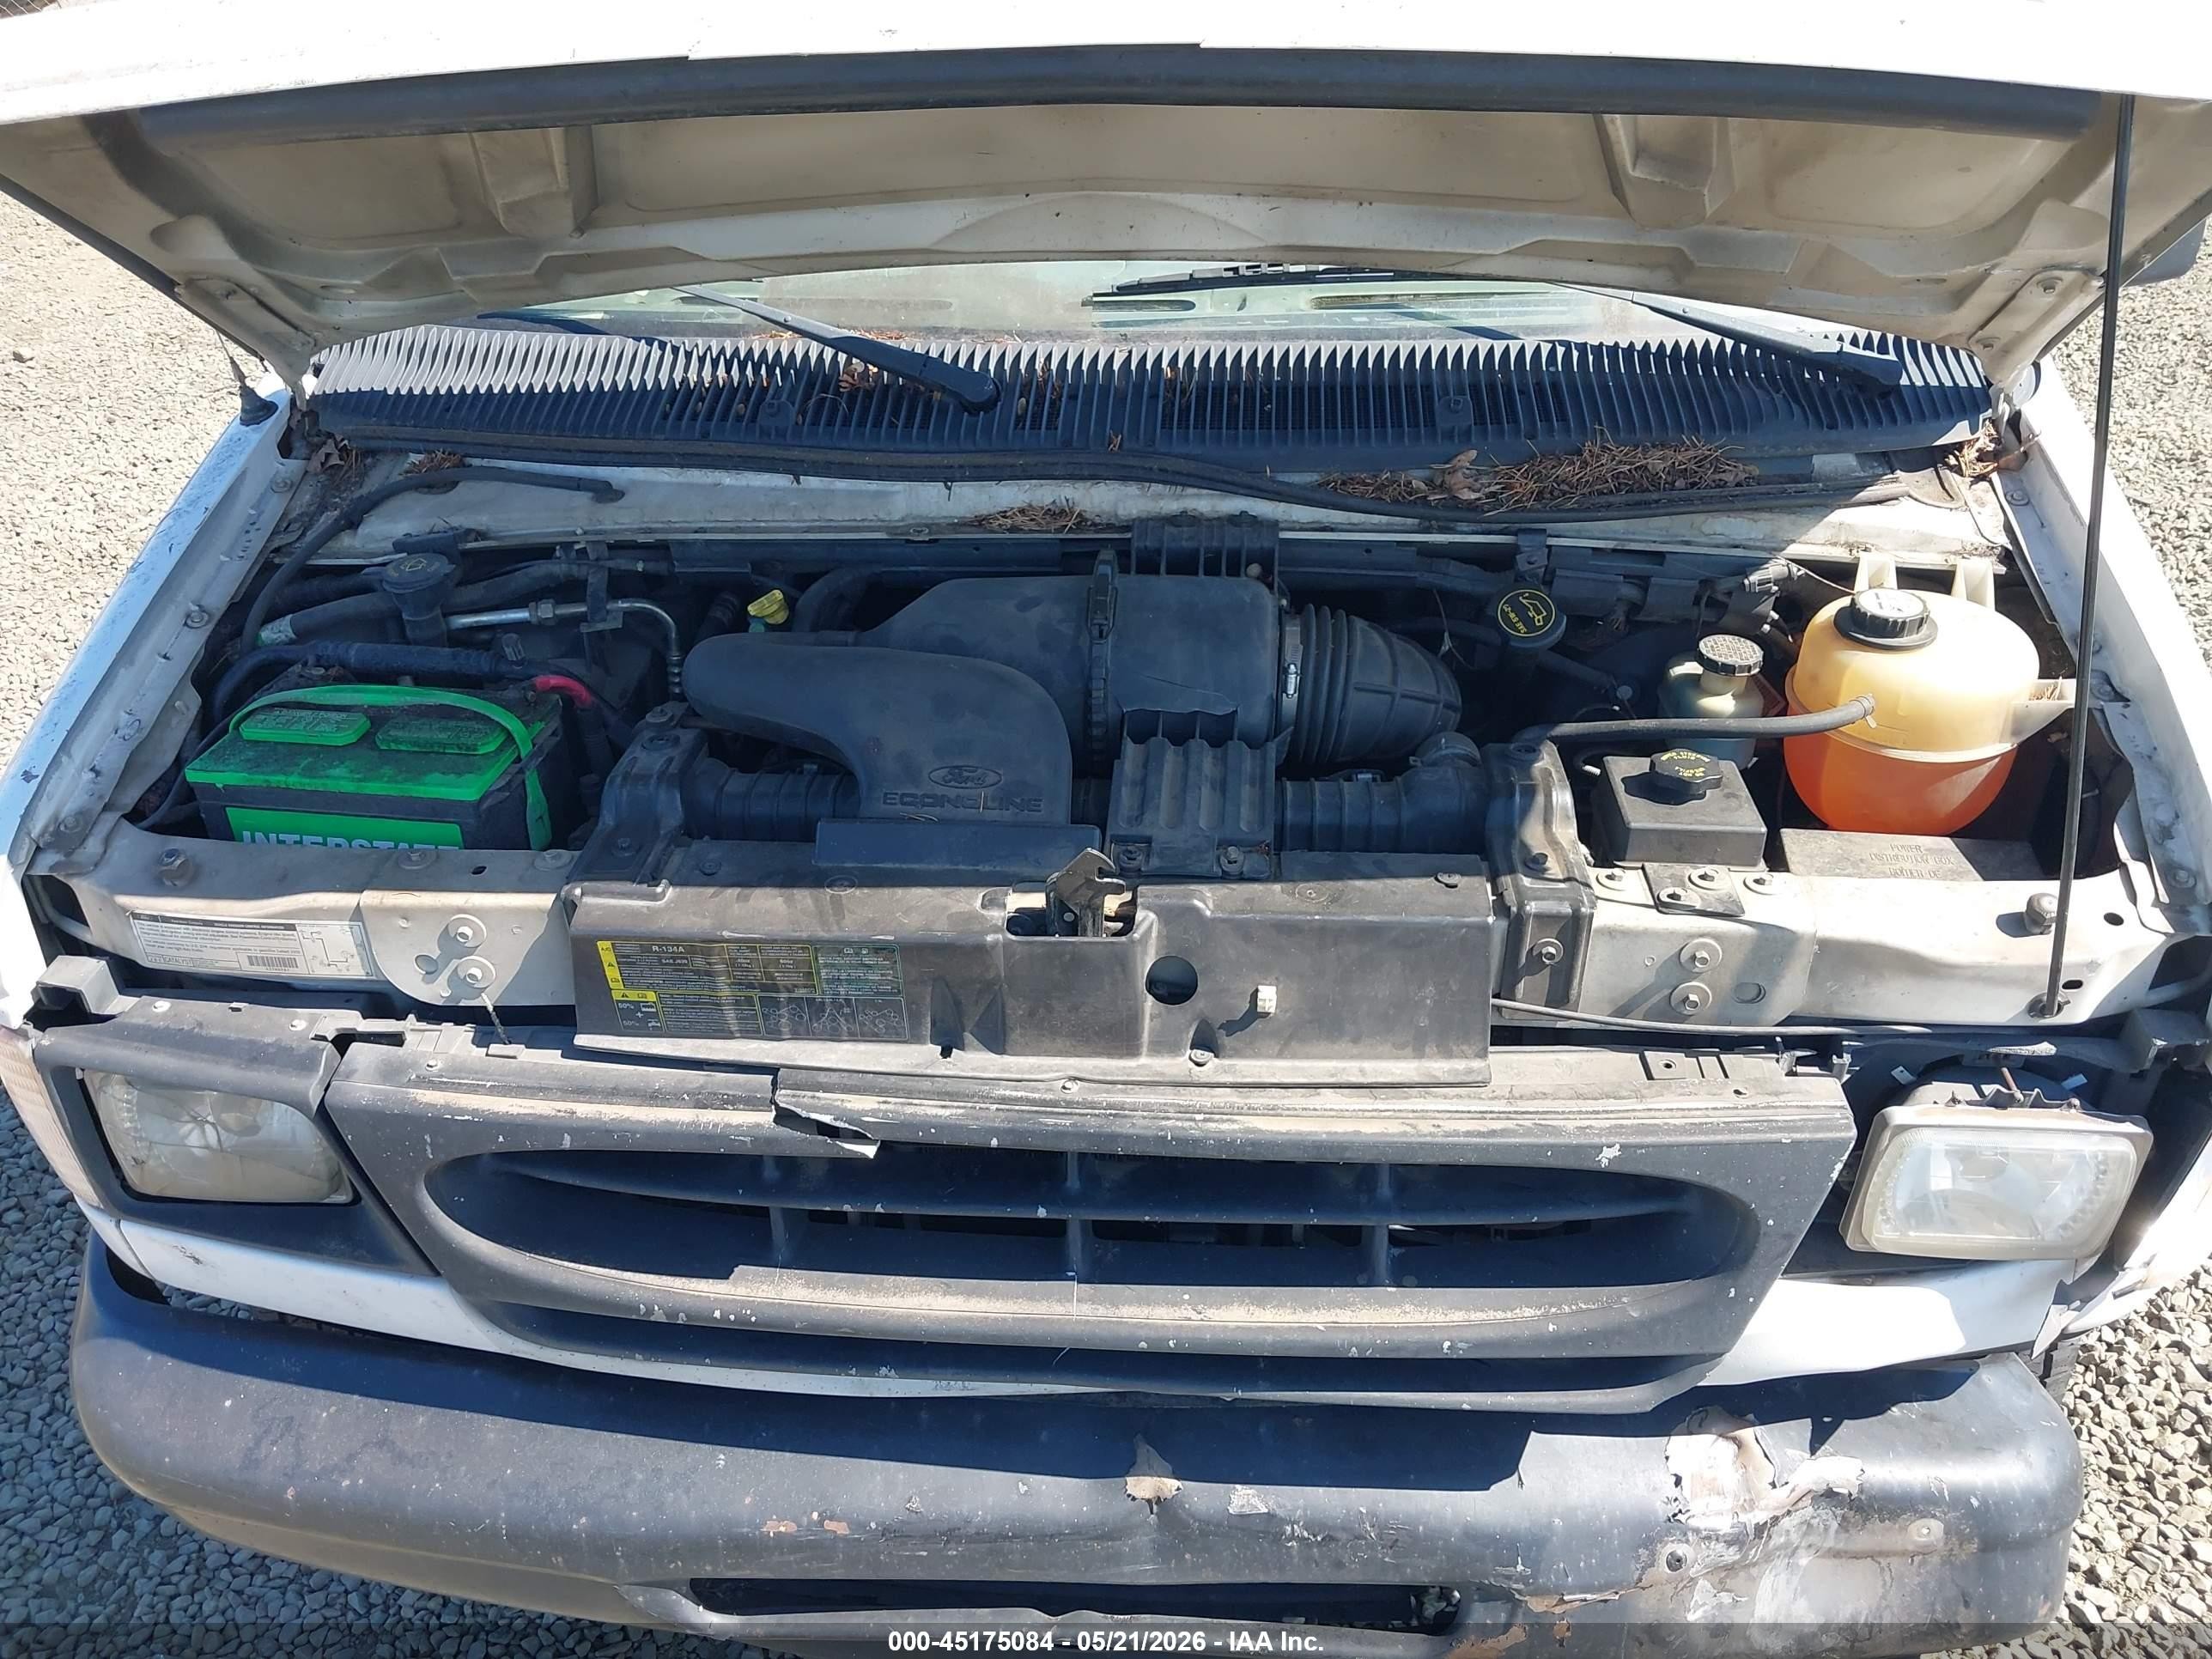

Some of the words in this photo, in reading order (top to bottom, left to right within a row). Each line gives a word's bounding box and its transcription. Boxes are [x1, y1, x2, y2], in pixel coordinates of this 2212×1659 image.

[882, 790, 1044, 812] ECONOLINE
[242, 830, 459, 850] INTERS
[1889, 843, 1923, 854] POWER
[1869, 853, 1930, 866] DISTRIBUTION
[1934, 856, 1955, 866] BOX
[1929, 870, 1942, 878] DE
